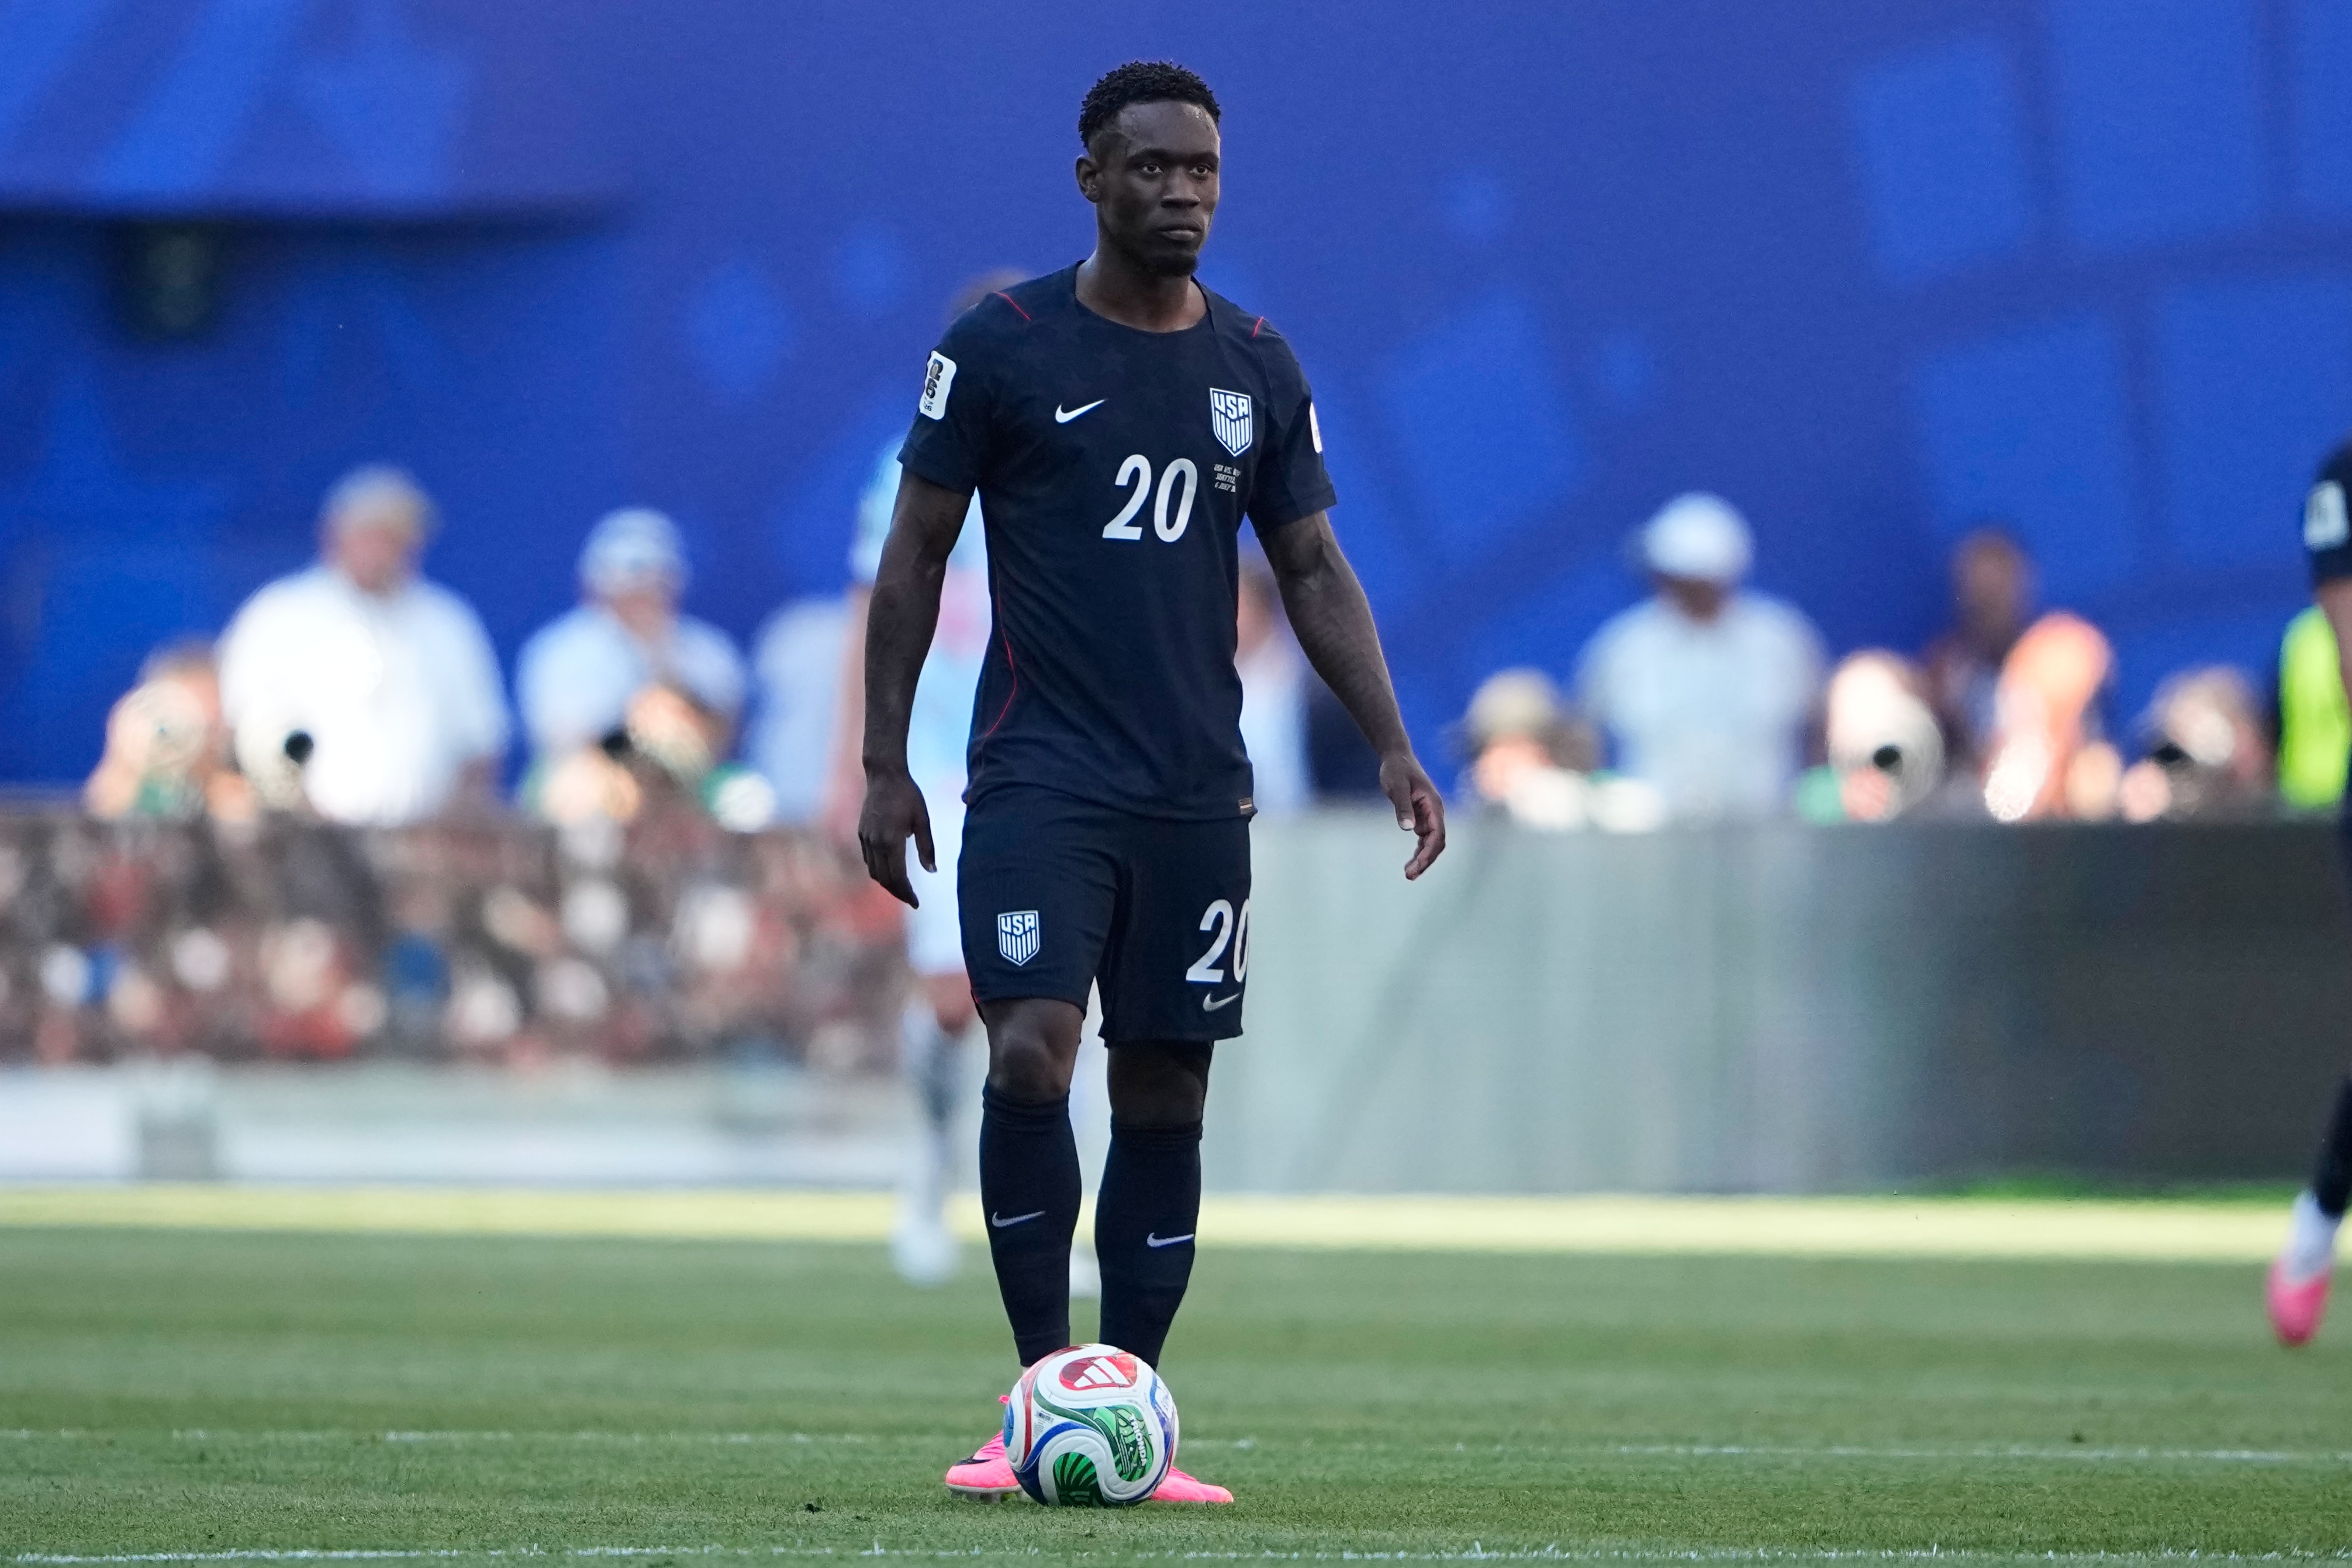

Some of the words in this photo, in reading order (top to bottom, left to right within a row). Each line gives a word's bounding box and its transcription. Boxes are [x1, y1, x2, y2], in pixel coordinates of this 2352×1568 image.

[1213, 392, 1249, 420] USA
[1102, 454, 1198, 543] 20
[1001, 914, 1035, 935] USA
[1186, 899, 1250, 983] 20
[1129, 1412, 1147, 1467] TRIONDA
